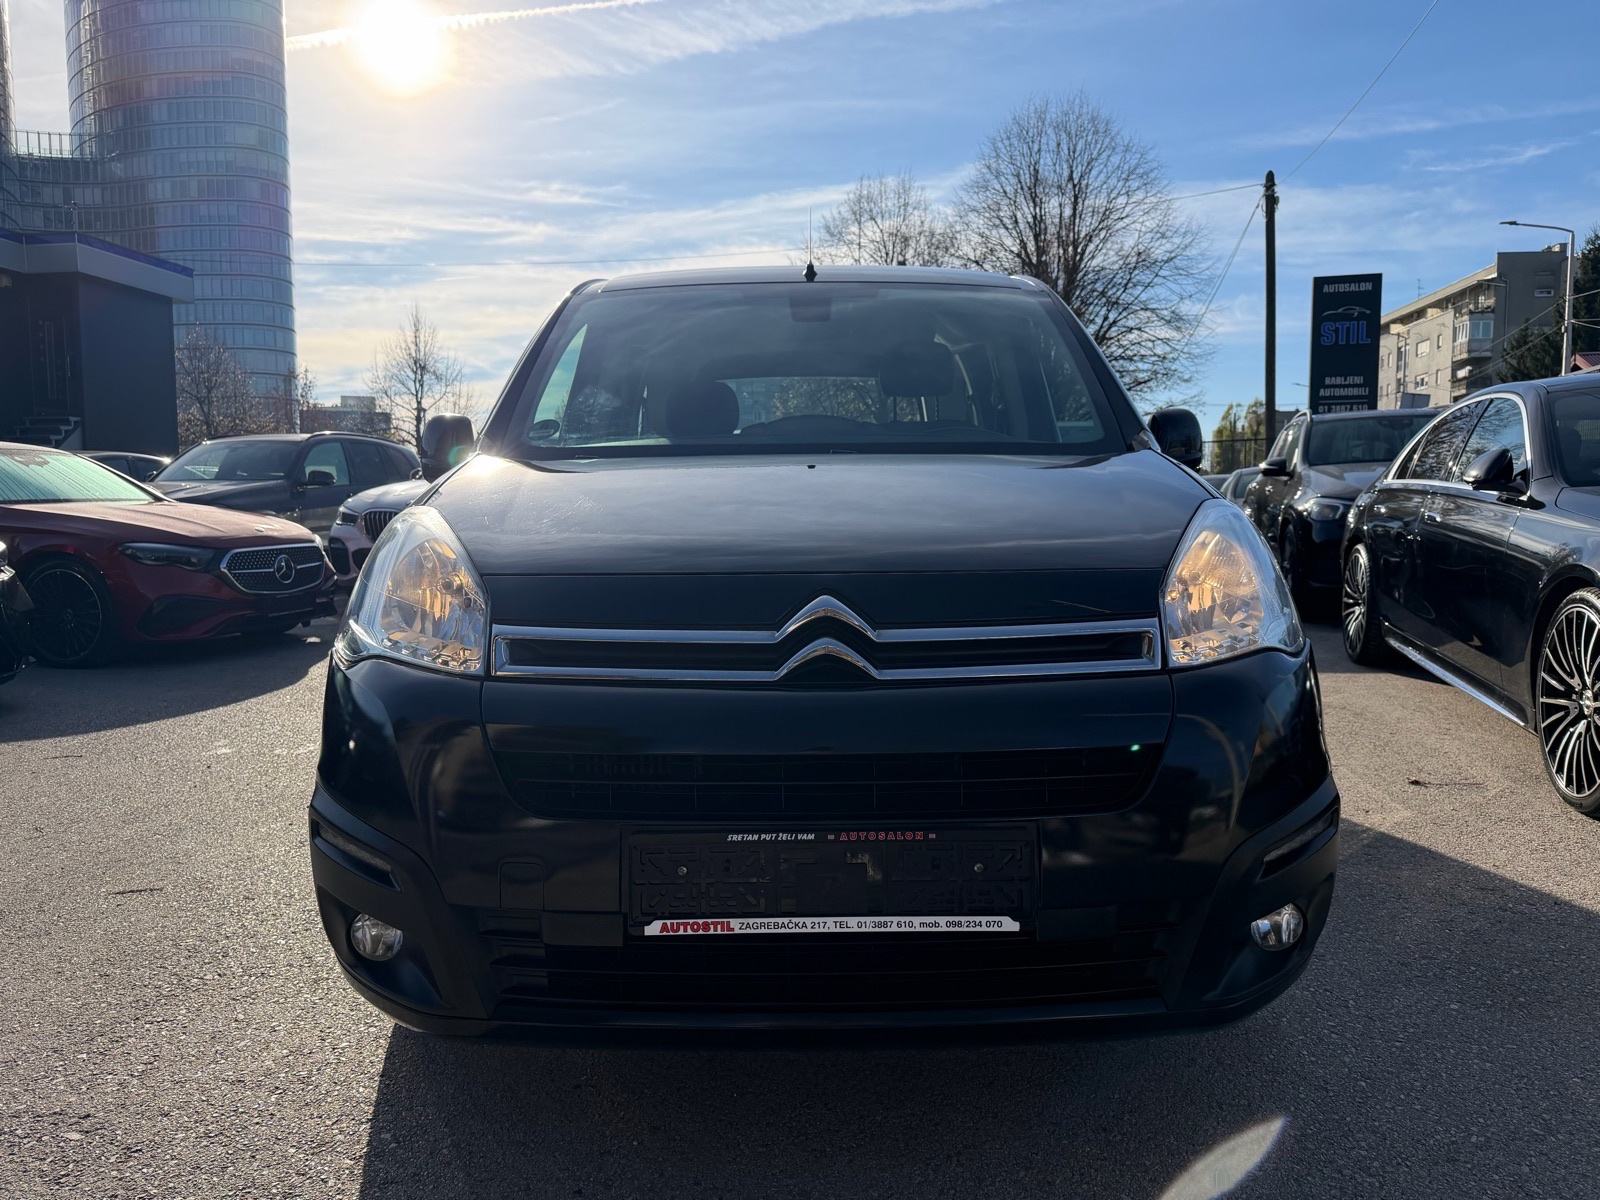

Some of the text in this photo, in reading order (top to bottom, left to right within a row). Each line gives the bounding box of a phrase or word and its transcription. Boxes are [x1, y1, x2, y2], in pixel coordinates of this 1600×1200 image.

[1323, 282, 1372, 293] AUTOSALON
[1320, 320, 1372, 346] STIL
[1325, 376, 1364, 385] RABLJENI
[1319, 386, 1369, 397] AUTOMOBILI
[839, 831, 924, 841] AUTOSALON
[659, 919, 1003, 934] AUTOSTIL ZAGREBAČKA 217, TEL. 01/3887 610, mob. 098/234 070
